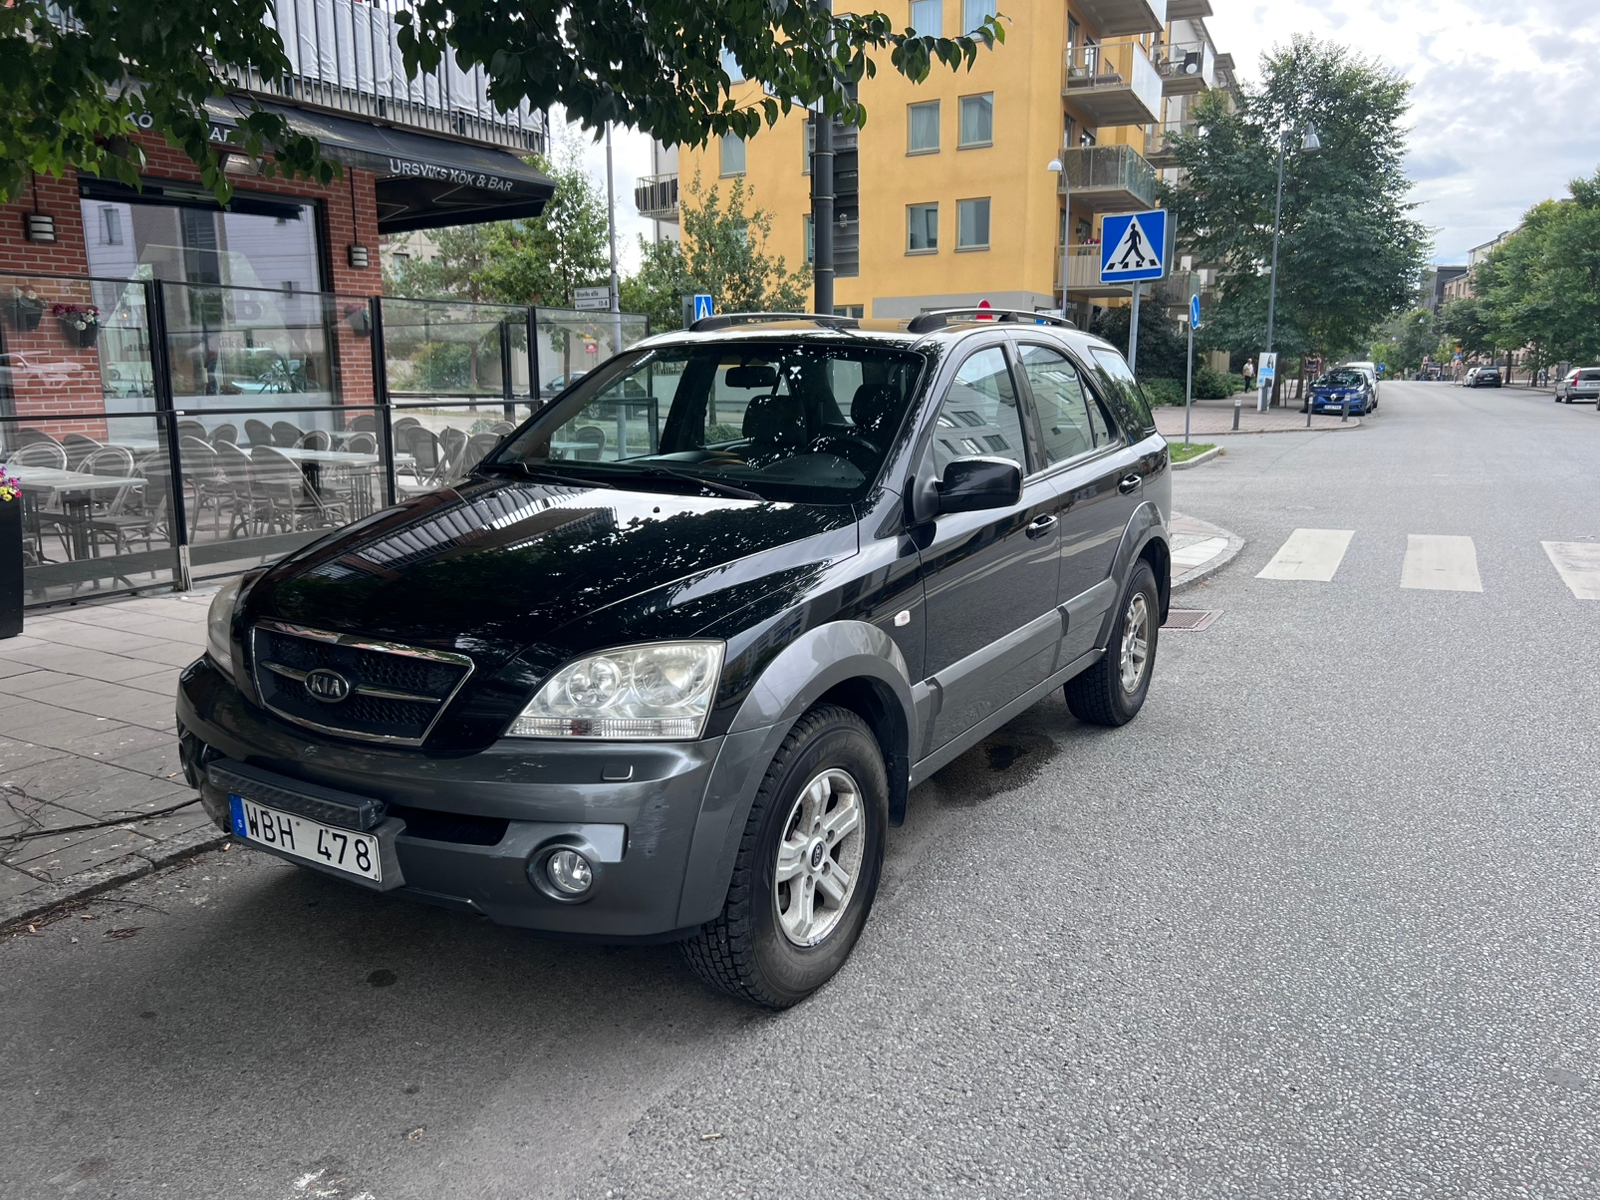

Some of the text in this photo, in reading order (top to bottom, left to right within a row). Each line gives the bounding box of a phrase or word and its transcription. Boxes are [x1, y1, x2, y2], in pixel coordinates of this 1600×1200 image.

[449, 168, 476, 186] KÖK
[476, 174, 487, 188] &
[487, 176, 514, 192] BAR
[311, 674, 342, 697] KIA
[238, 819, 243, 828] S
[245, 803, 371, 872] WBH 478
